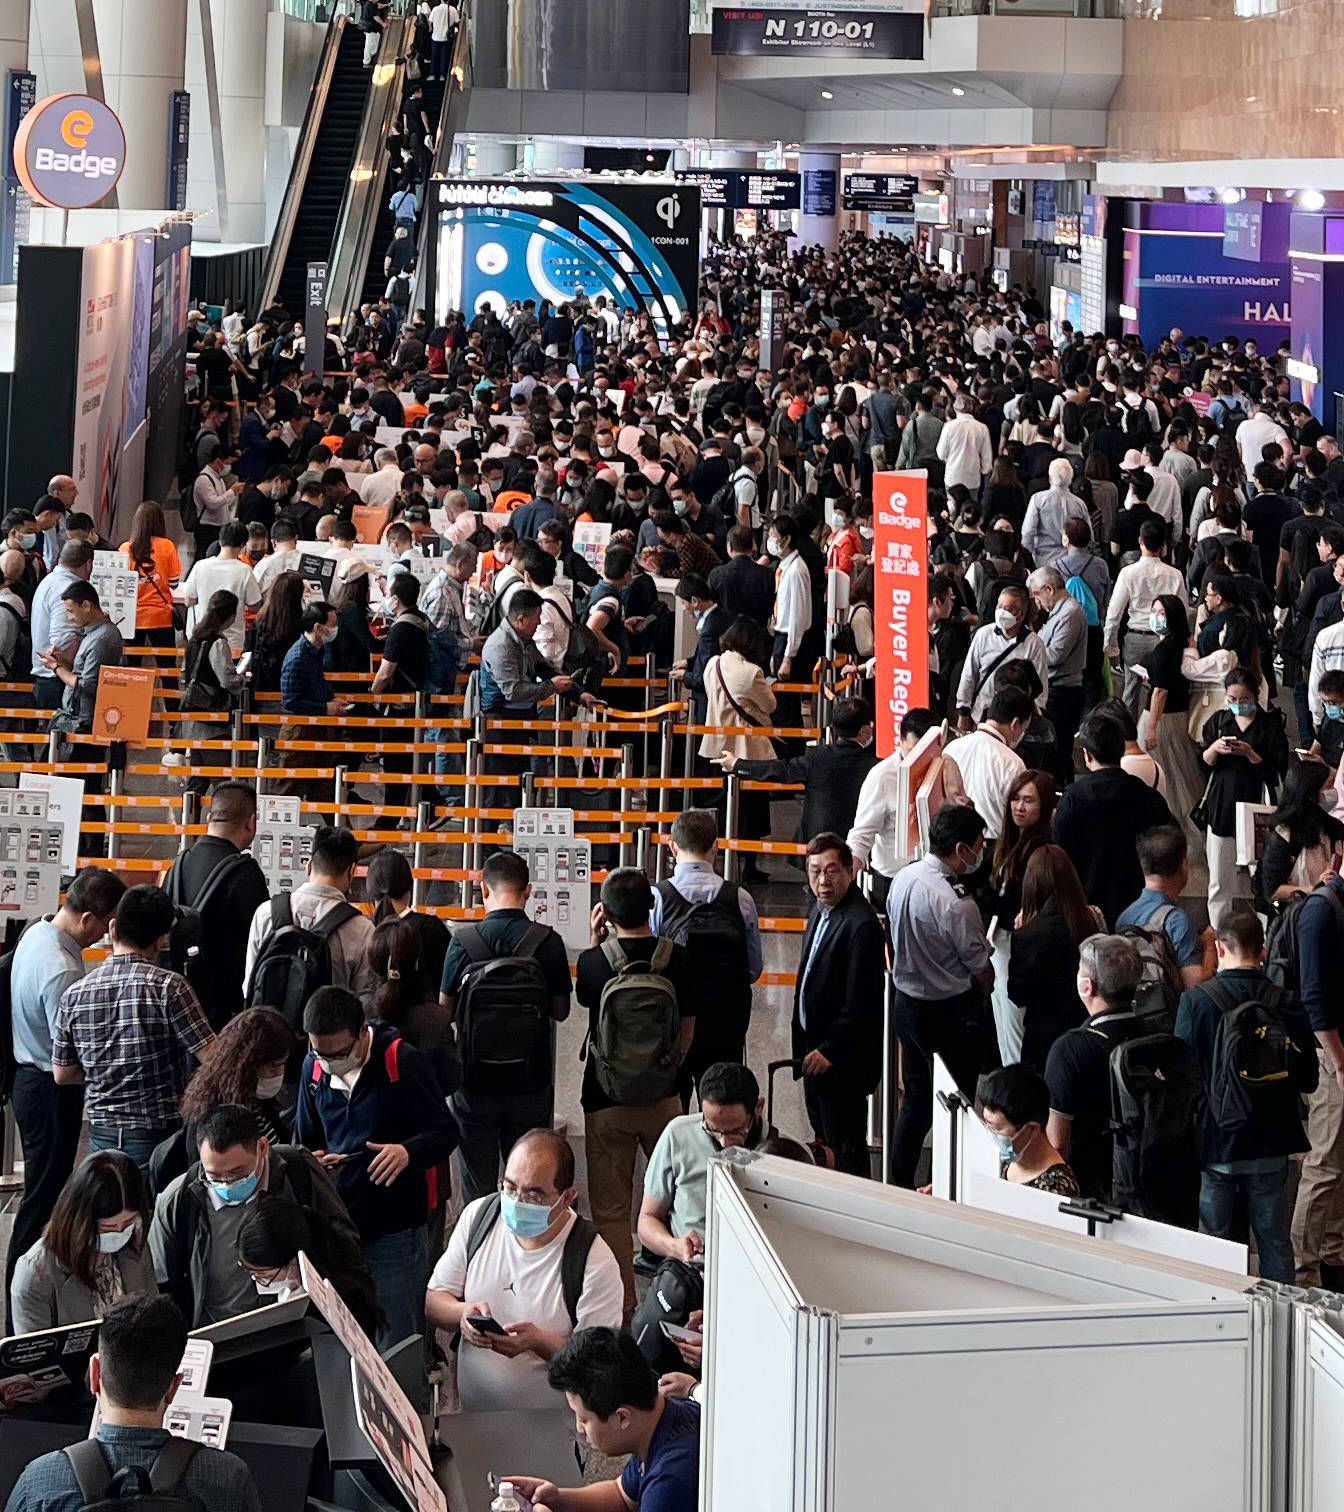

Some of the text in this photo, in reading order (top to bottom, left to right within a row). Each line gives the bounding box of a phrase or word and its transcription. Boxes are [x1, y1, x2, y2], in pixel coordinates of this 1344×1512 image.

[765, 19, 874, 39] N 110-01
[36, 147, 117, 178] Badge
[1155, 274, 1280, 287] DIGITAL ENTERTAINMENT
[878, 511, 921, 530] Badge
[892, 588, 911, 662] Buyer
